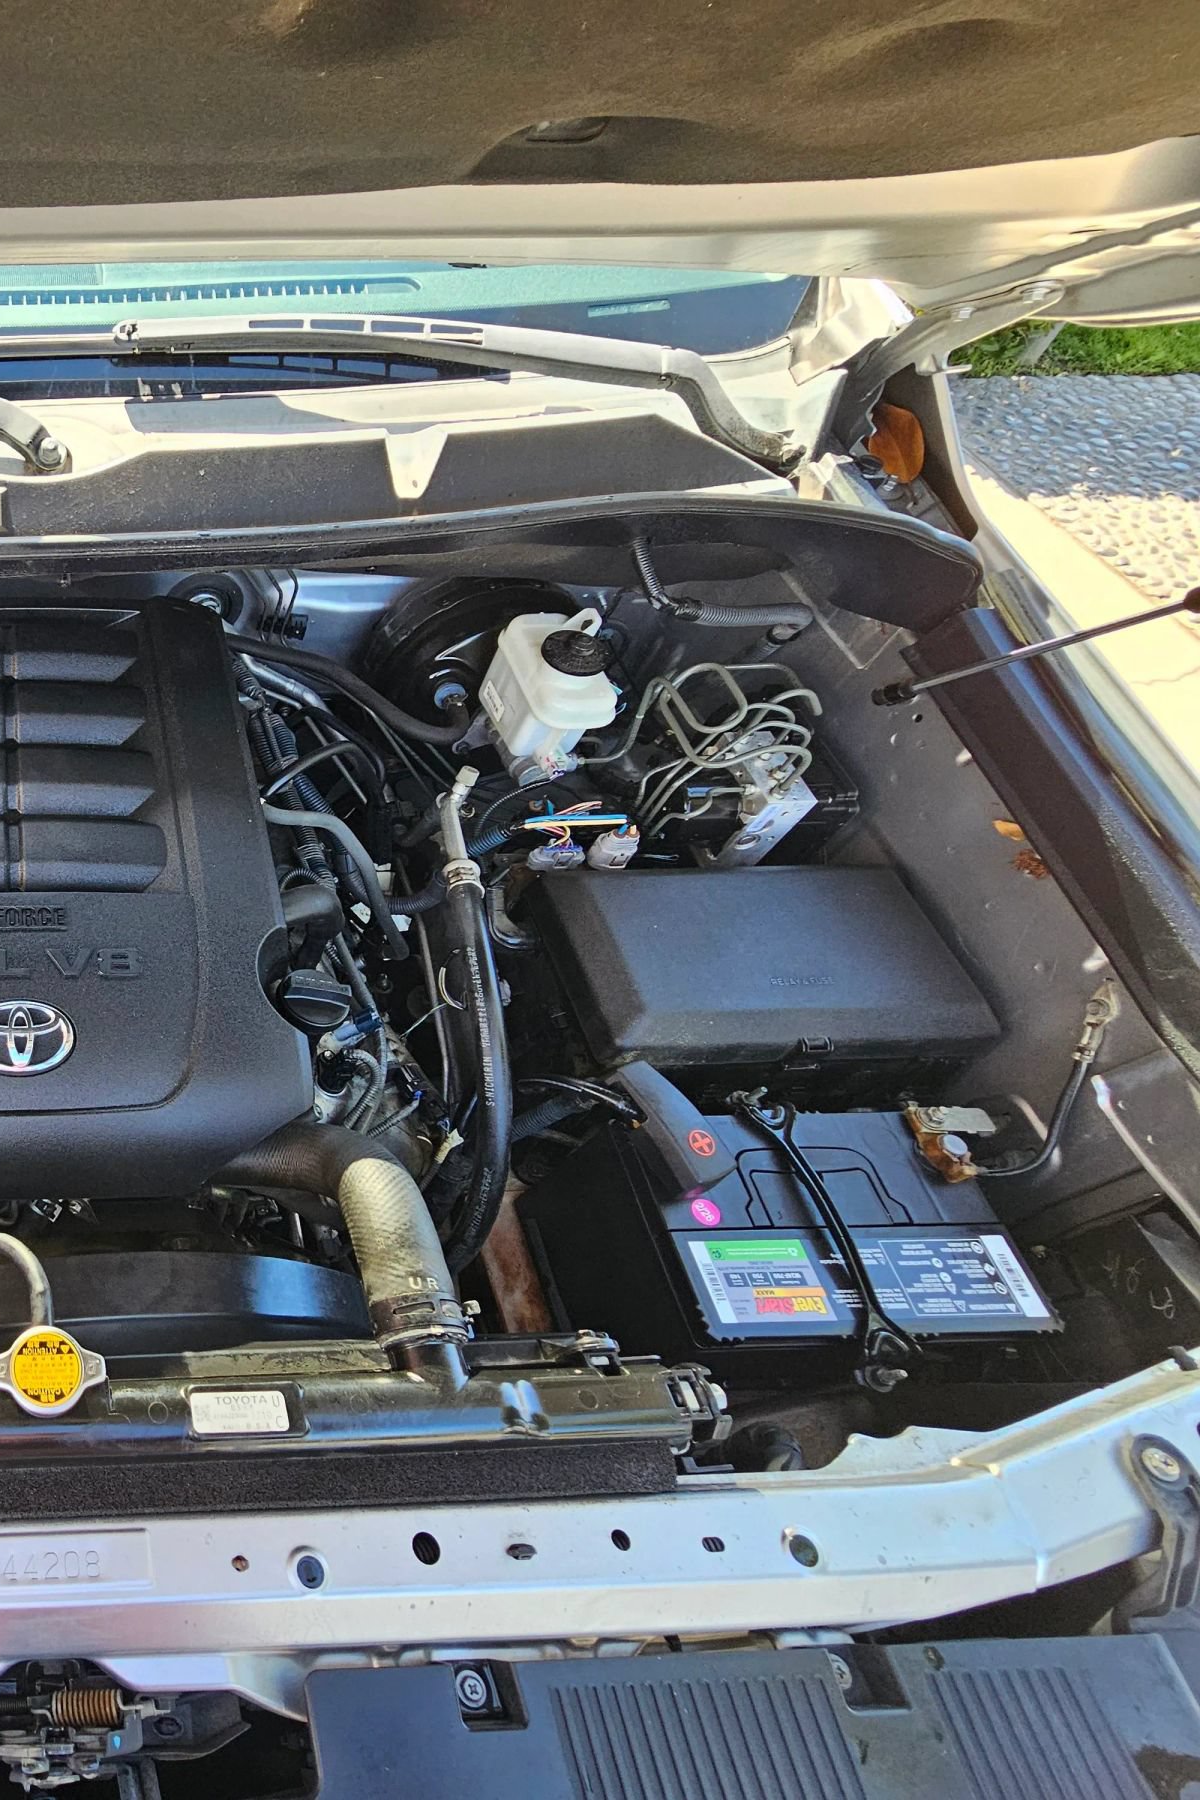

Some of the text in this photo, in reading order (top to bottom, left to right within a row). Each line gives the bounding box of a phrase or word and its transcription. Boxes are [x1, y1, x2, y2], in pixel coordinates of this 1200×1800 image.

[47, 948, 143, 979] V8
[755, 1297, 828, 1315] EverStart
[27, 1388, 61, 1396] CAUTION
[215, 1395, 268, 1405] TOYOTA
[2, 1550, 102, 1581] 44208
